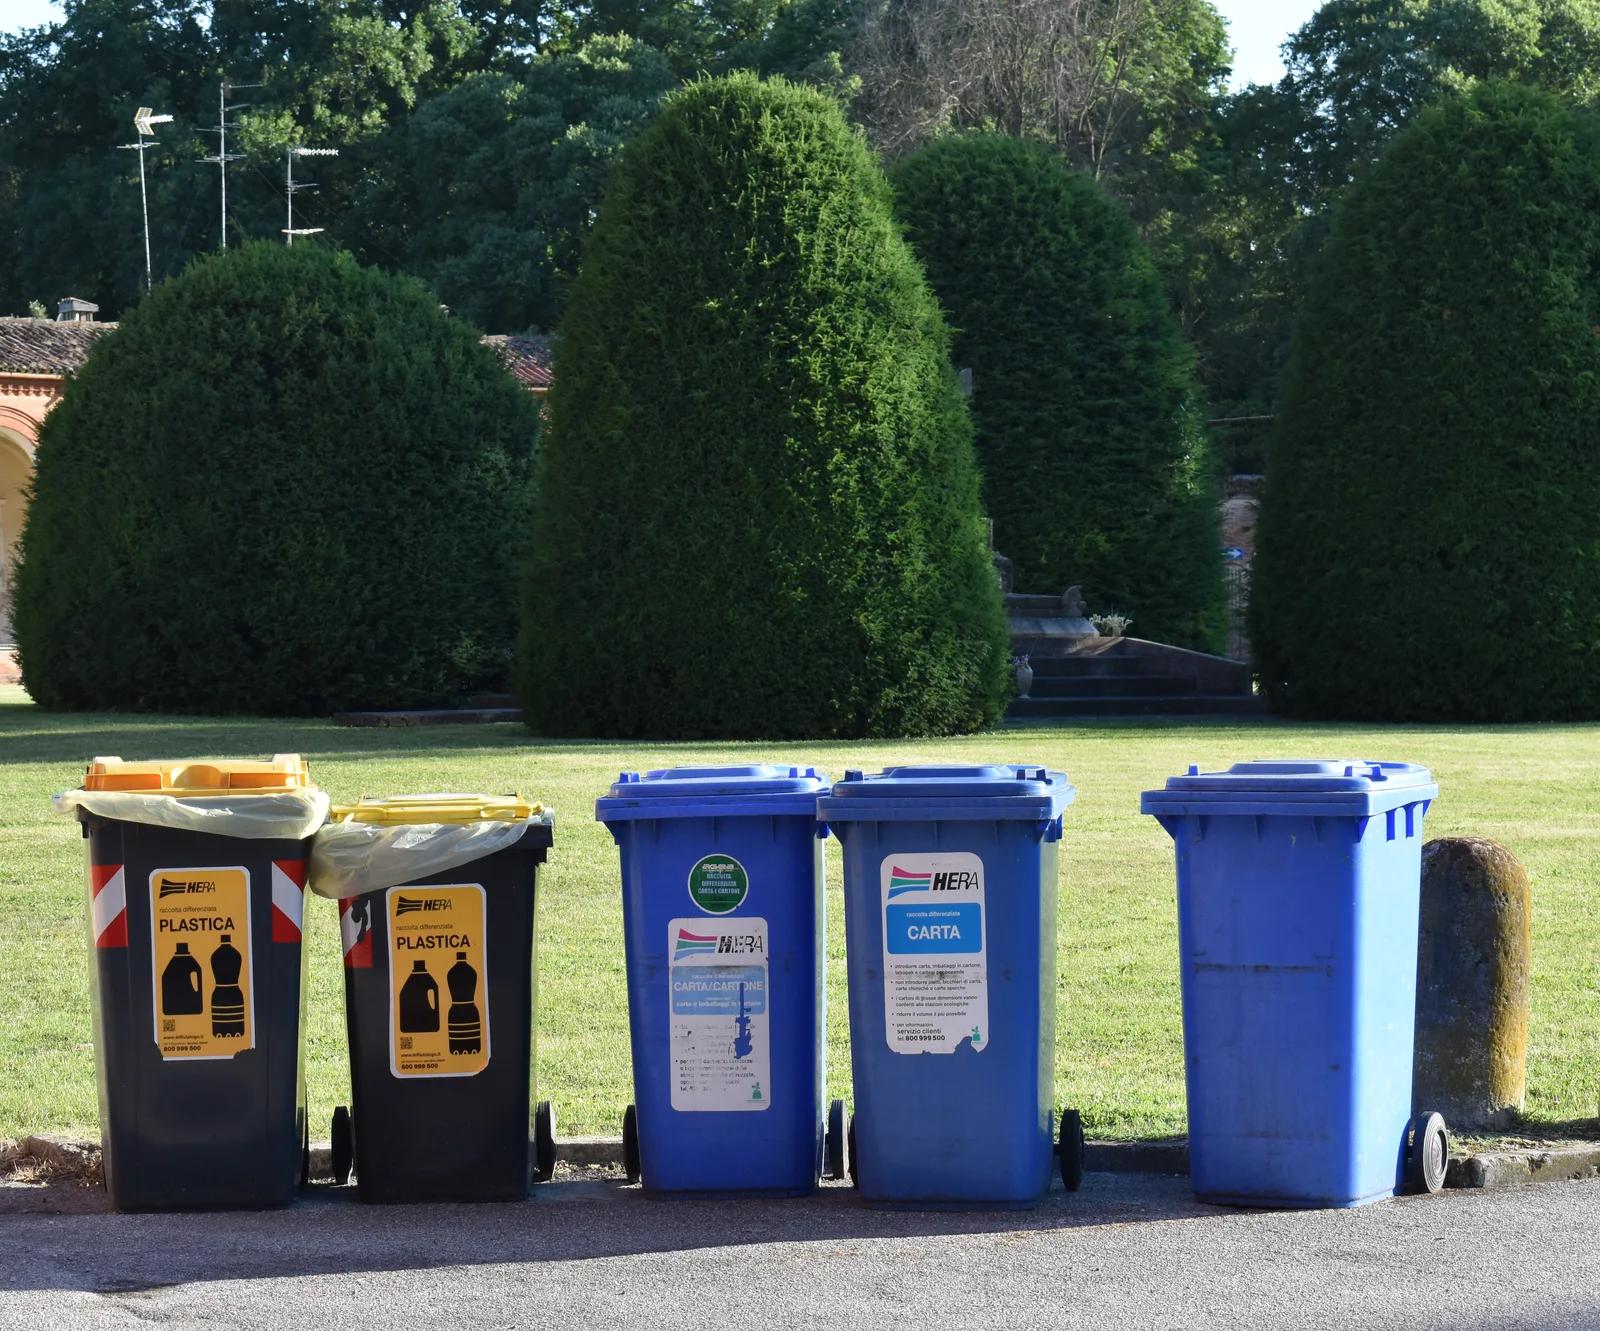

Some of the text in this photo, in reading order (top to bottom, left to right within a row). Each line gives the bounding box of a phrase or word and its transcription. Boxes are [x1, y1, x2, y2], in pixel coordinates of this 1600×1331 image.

[187, 881, 216, 893] HERA
[933, 872, 979, 890] HERA
[424, 899, 452, 911] HERA
[160, 917, 235, 932] PLASTICA
[907, 925, 961, 940] CARTA
[397, 934, 470, 950] PLASTICA
[718, 936, 763, 953] HERA
